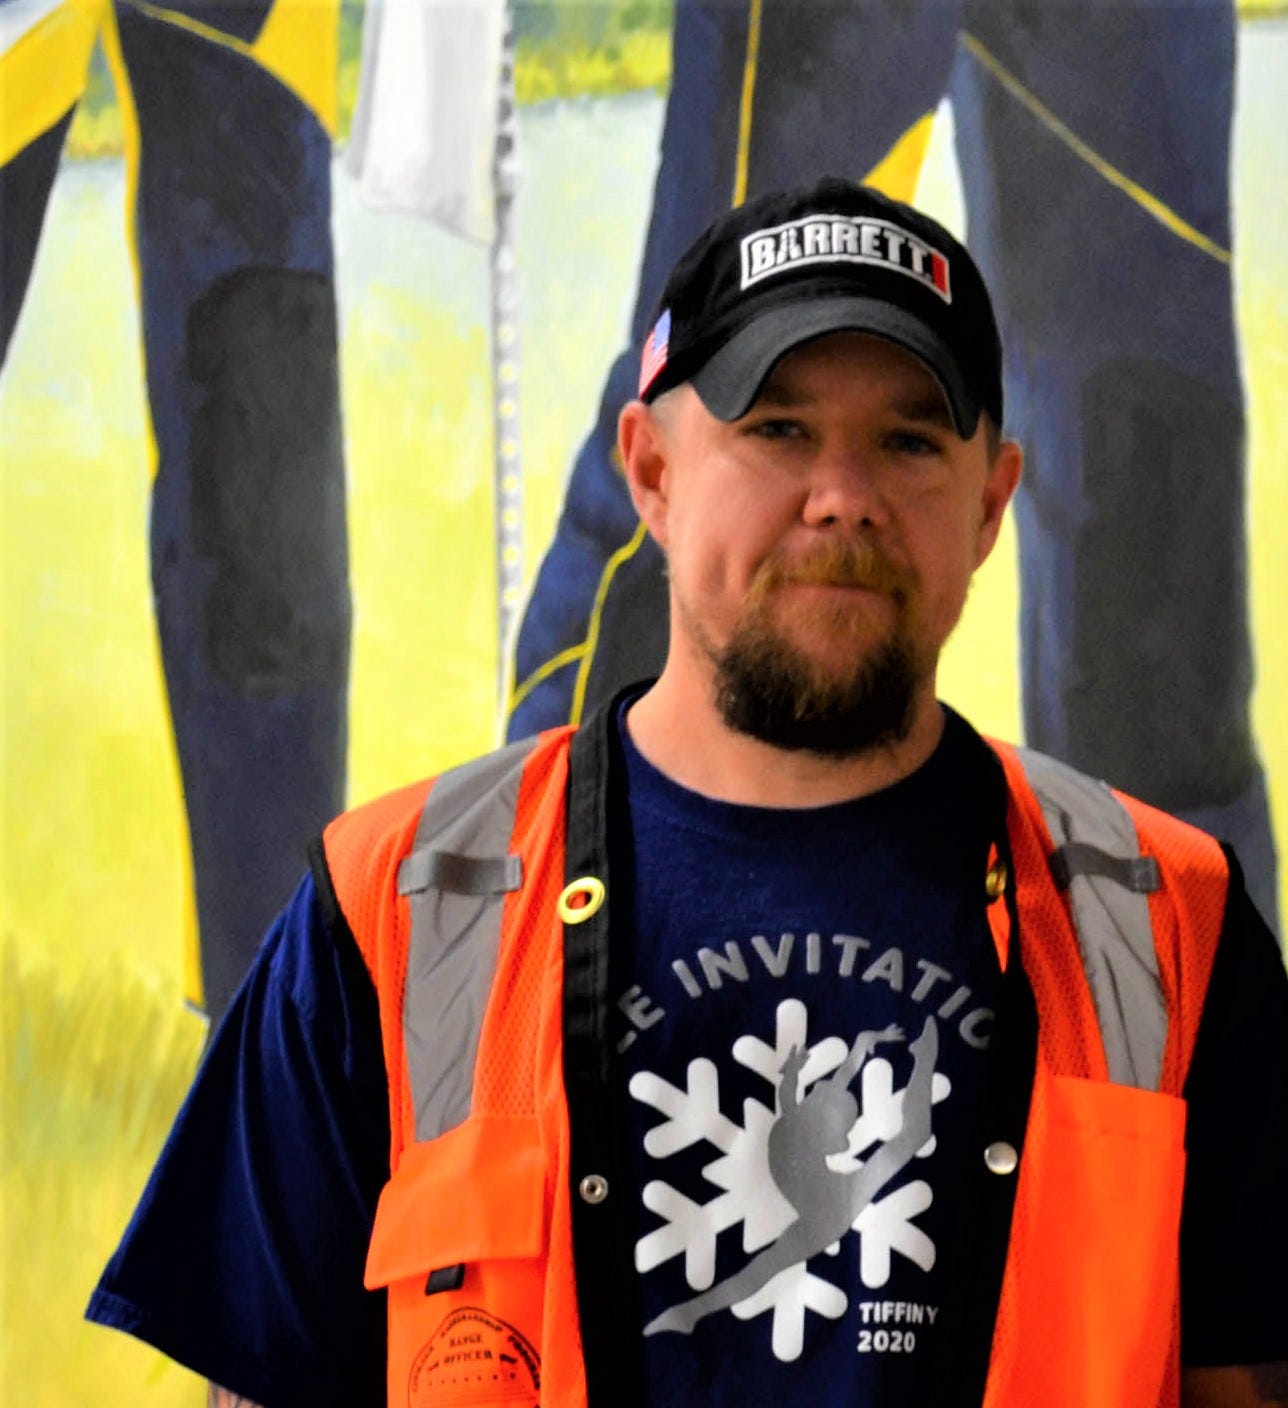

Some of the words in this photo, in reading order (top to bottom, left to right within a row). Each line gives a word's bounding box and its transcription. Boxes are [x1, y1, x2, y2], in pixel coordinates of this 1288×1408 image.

[750, 220, 930, 276] BARRETT
[858, 1301, 939, 1324] TIFFINY
[857, 1330, 916, 1353] 2020
